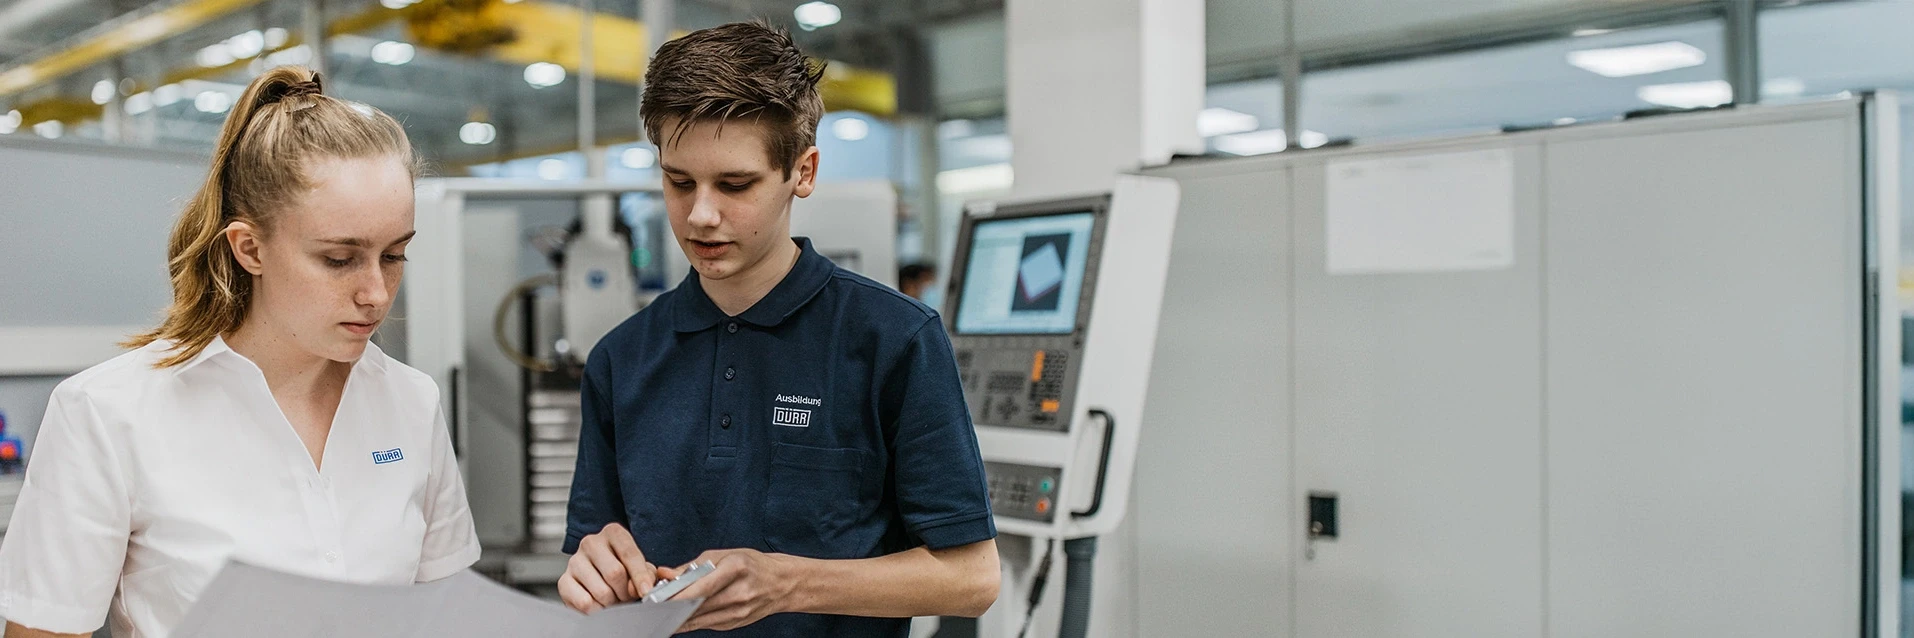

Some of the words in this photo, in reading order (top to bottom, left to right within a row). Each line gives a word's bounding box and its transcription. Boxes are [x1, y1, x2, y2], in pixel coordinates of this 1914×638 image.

[775, 394, 821, 406] Ausbildung
[777, 408, 807, 424] DÜRR
[376, 451, 400, 461] DÜRR
